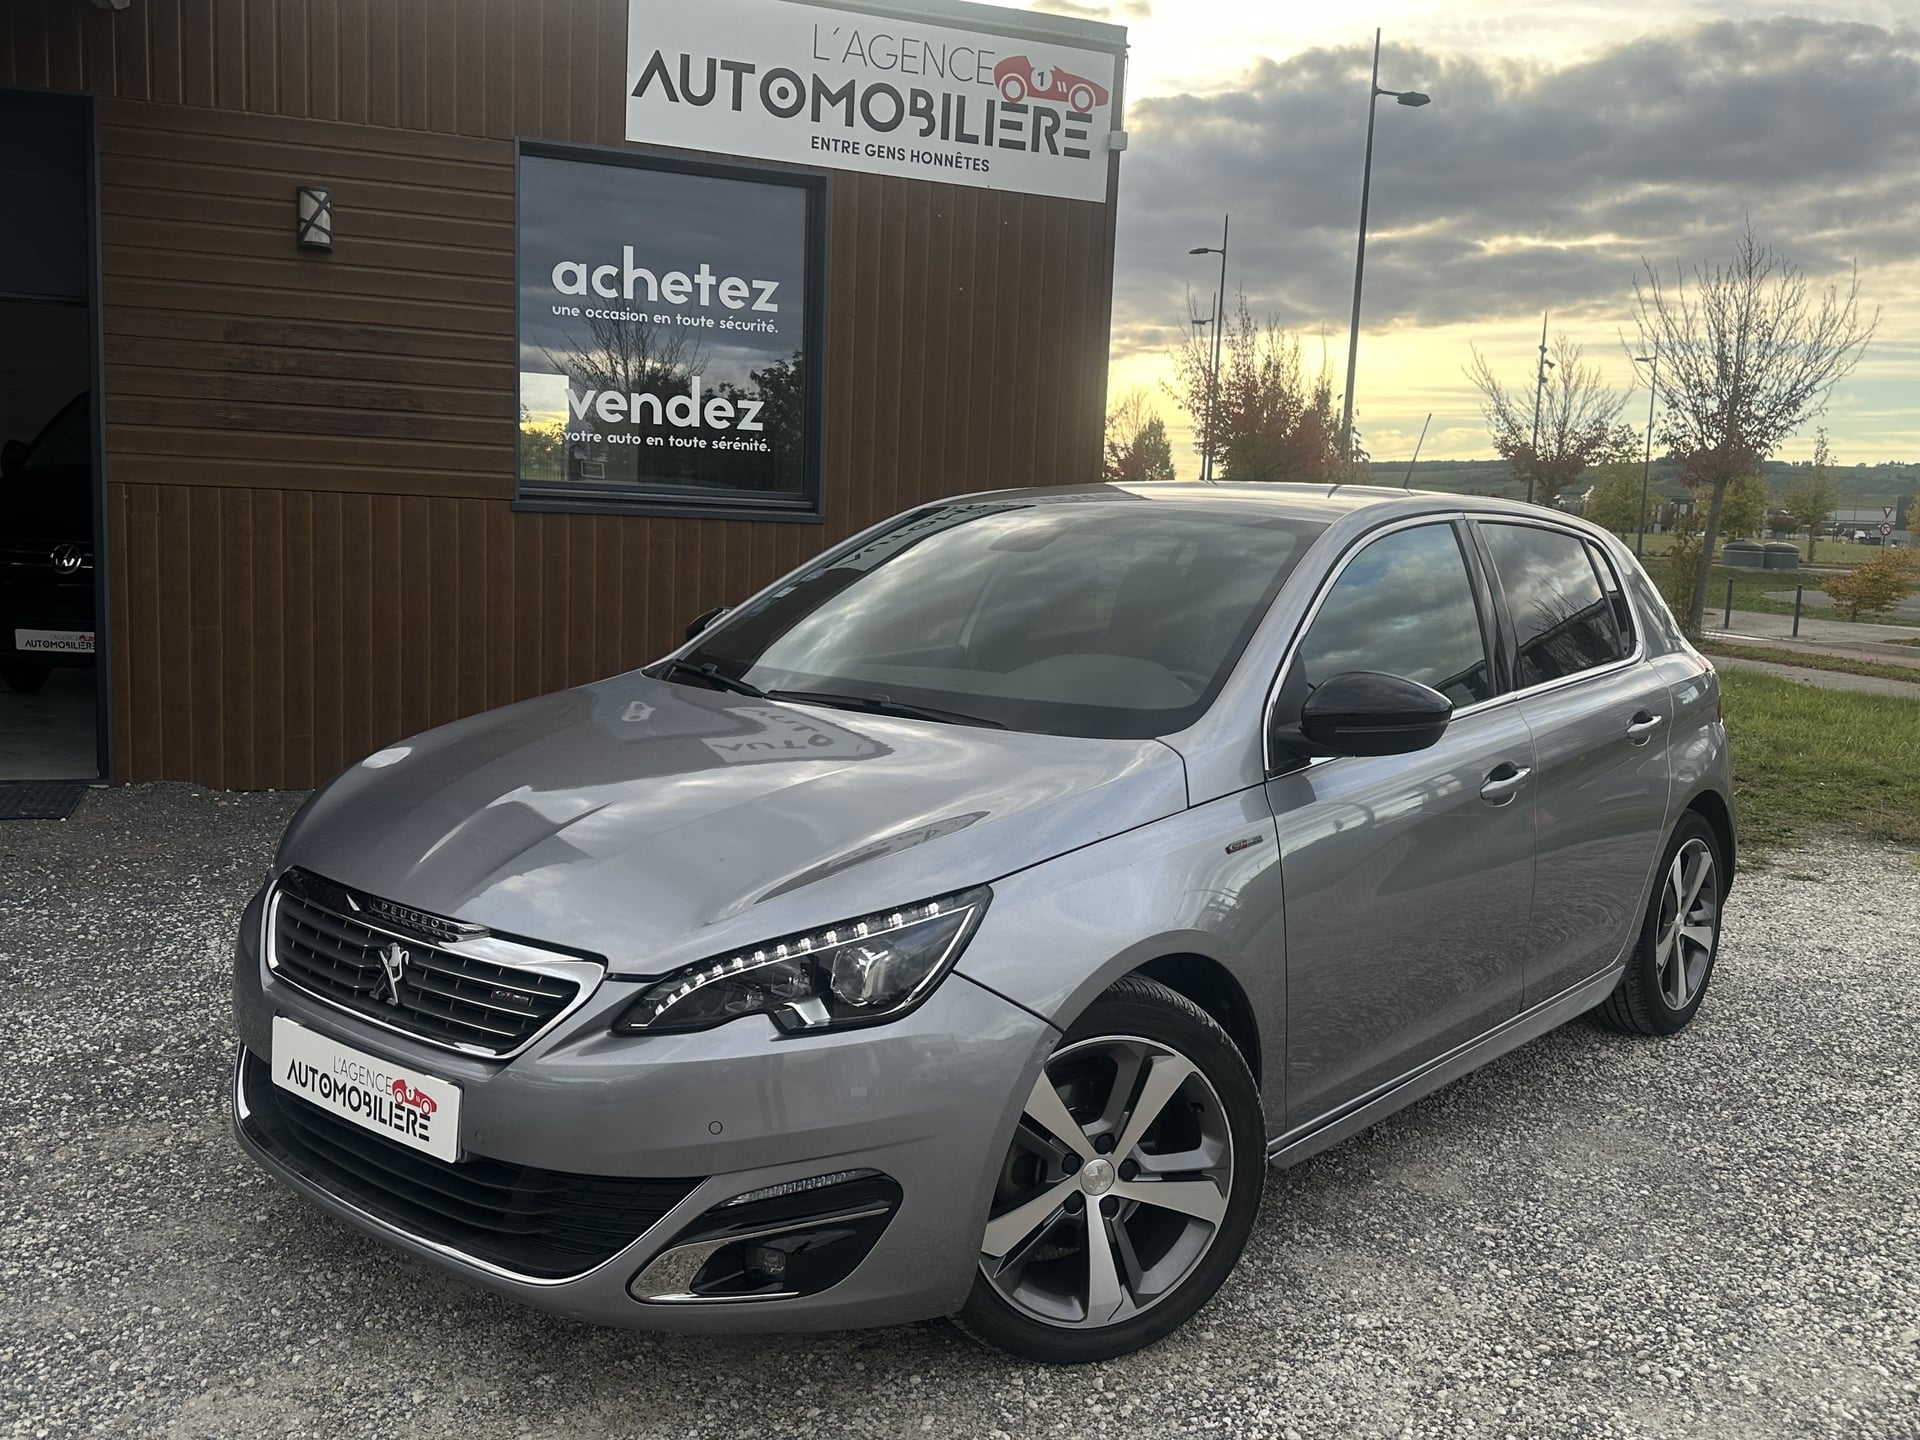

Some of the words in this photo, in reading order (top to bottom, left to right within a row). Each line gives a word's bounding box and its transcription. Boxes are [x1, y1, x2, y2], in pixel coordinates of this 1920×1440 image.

[1037, 71, 1044, 86] 1
[631, 49, 1093, 160] AUTOMOBILIERE
[811, 135, 860, 155] ENTRE
[865, 143, 906, 161] GENS
[910, 149, 990, 172] HONNÊTES
[551, 245, 780, 313] achetez
[552, 305, 580, 317] une
[585, 307, 648, 322] occasion
[653, 312, 671, 324] en
[675, 313, 715, 329] toute
[719, 316, 778, 333] sécurité.
[563, 375, 765, 432] vendez
[563, 430, 602, 443] votre
[607, 433, 641, 445] auto
[646, 436, 663, 447] en
[668, 435, 707, 449] toute
[711, 437, 772, 453] sérénité.
[381, 902, 451, 931] PEUGEOT
[333, 1055, 393, 1096] L'AGENCE
[287, 1058, 431, 1142] AUTOMOBILIERE
